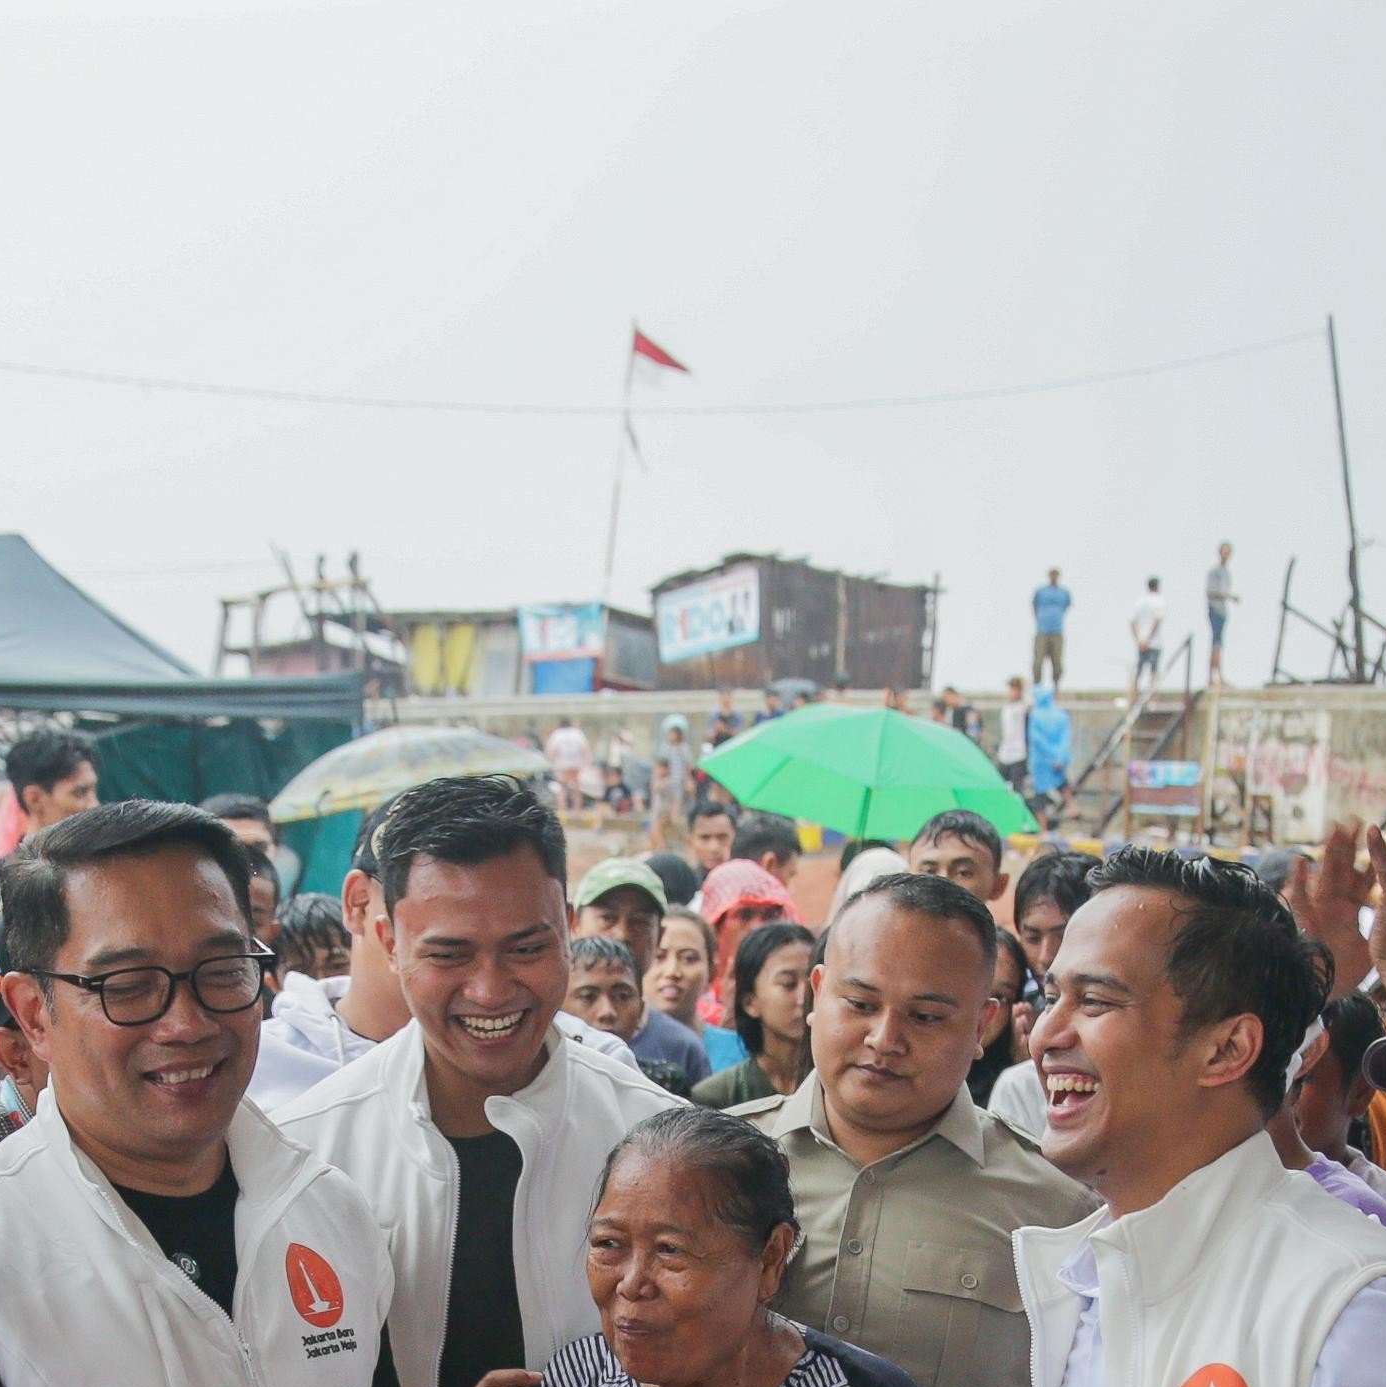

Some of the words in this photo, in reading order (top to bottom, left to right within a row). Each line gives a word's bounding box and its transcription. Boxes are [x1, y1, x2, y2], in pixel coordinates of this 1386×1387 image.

[301, 1331, 337, 1346] Jakarta
[336, 1328, 355, 1339] Baru
[305, 1343, 341, 1359] Jakarta
[341, 1338, 358, 1352] Maju
